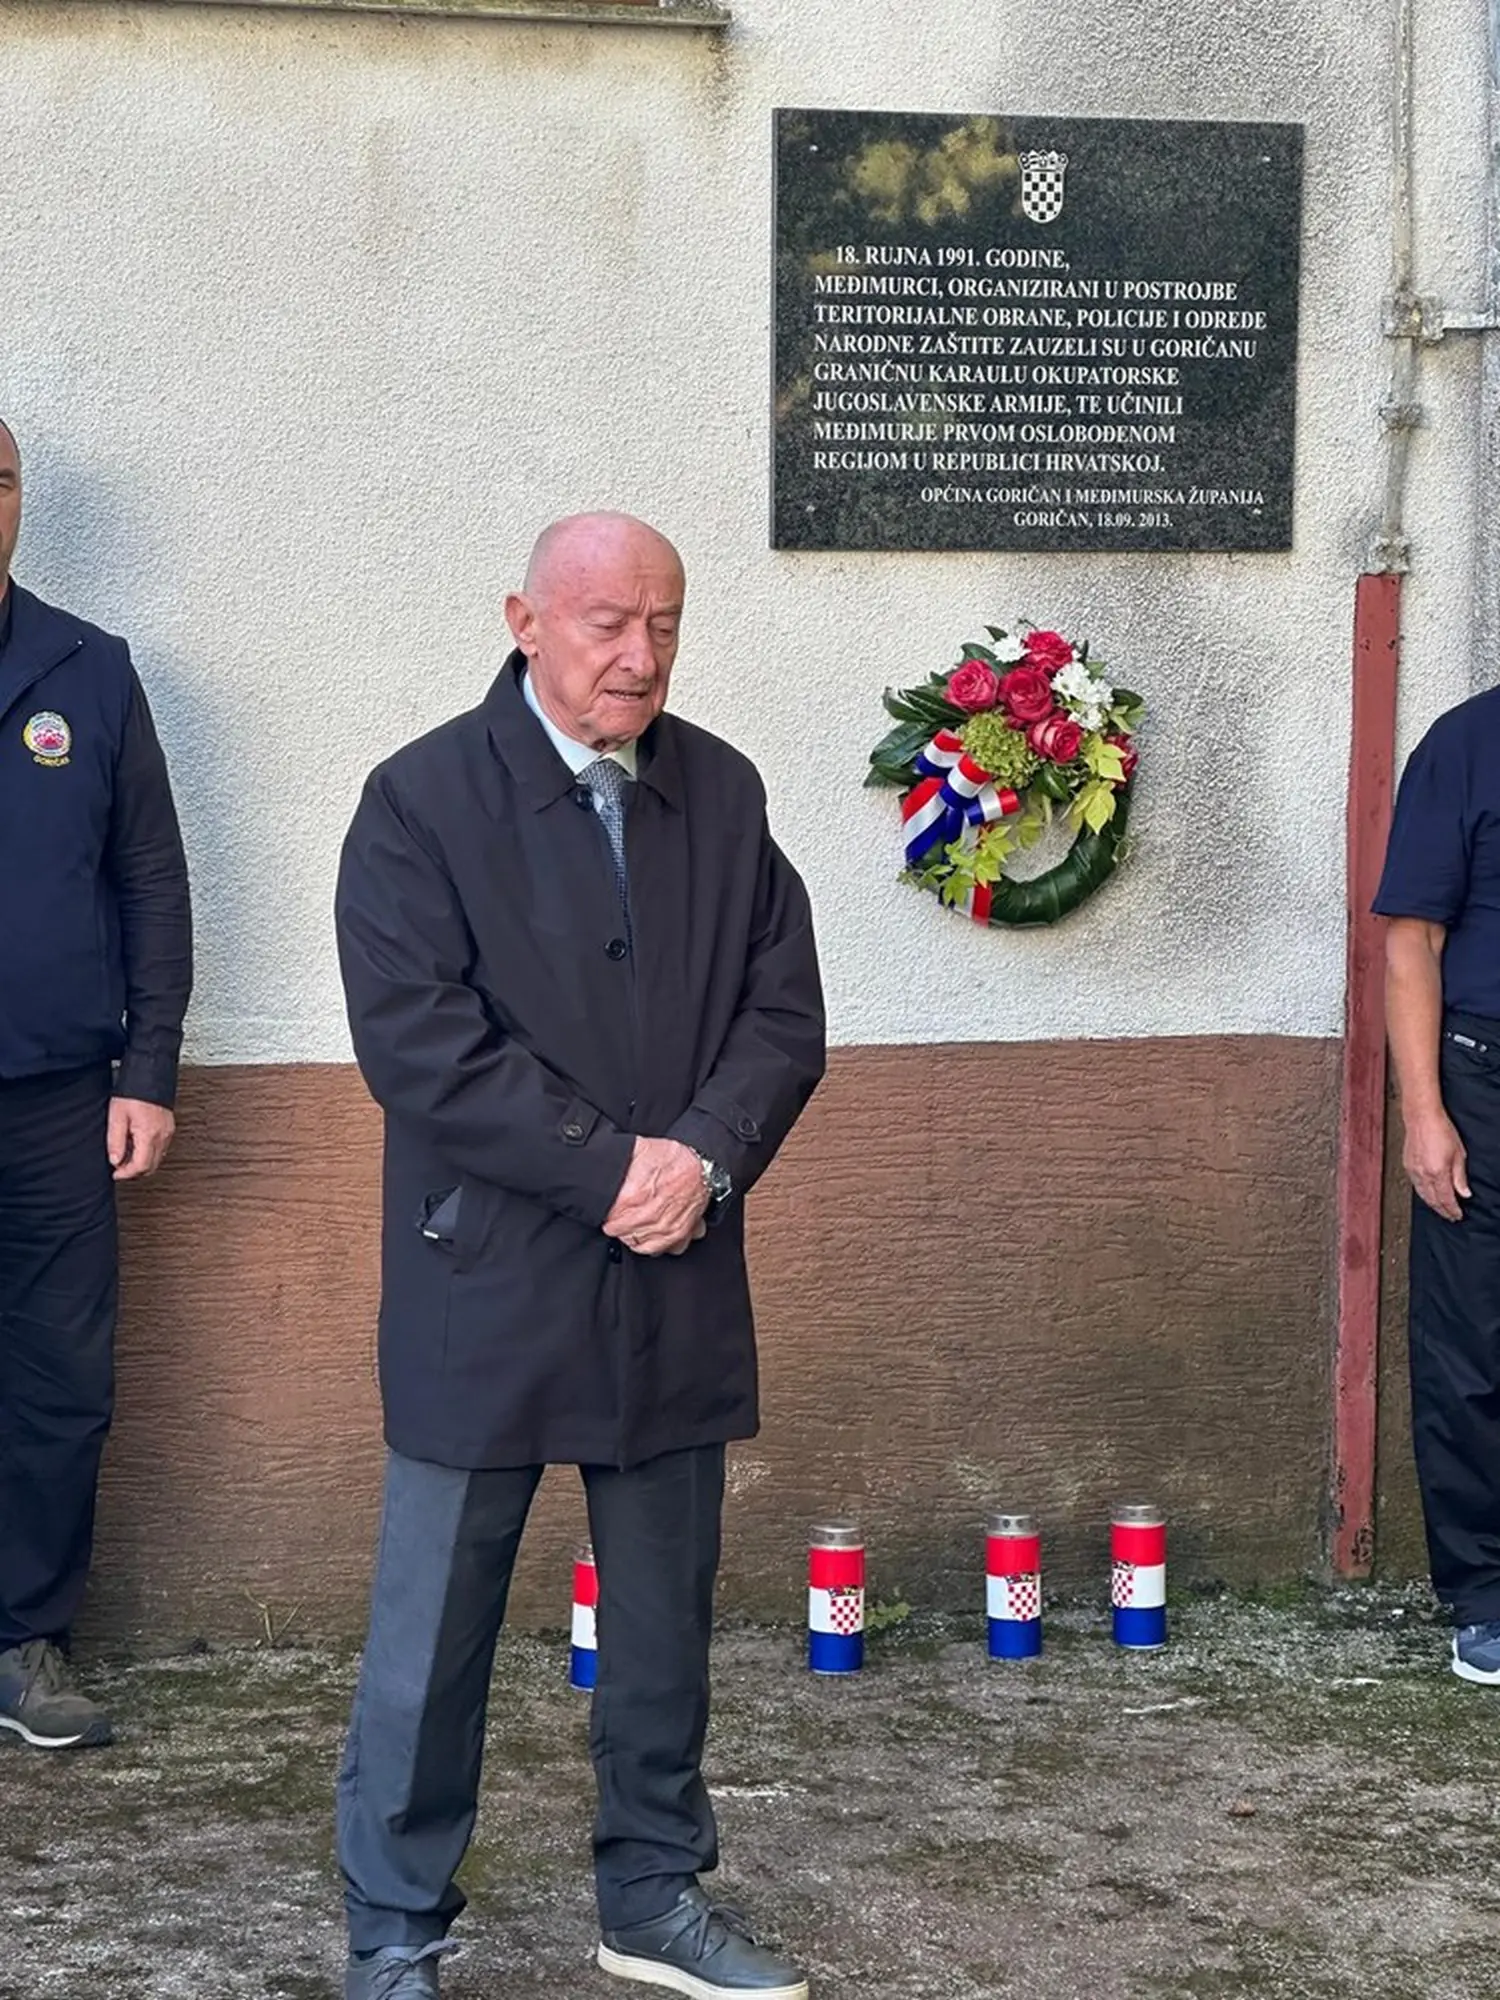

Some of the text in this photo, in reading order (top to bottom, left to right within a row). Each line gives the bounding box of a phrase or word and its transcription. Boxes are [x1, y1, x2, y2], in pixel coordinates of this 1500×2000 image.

[836, 246, 1070, 271] 18. RUJNA 1991. GODINE,
[815, 275, 1237, 301] MEĐIMURCI, ORGANIZIRANI U POSTROJBE
[814, 304, 1266, 330] TERITORIJALNE OBRANE, POLICIJE I ODREDE
[814, 331, 1257, 358] NARODNE ZAŠTITE ZAUZELI SU U GORIČANU
[814, 359, 1179, 385] GRANIČNU KARAULU OKUPATORSKE
[813, 391, 1183, 416] JUGOSLAVENSKE ARMIJE, TE UČINILI
[813, 422, 937, 441] MEĐIMURJE
[944, 424, 1015, 442] PRVOM
[814, 451, 1165, 473] REGIJOM U REPUBLICI HRVATSKOJ.
[921, 484, 982, 503] OPĆINA
[986, 486, 1060, 504] GORIČAN
[1065, 489, 1070, 503] I
[1189, 485, 1264, 505] ŽUPANIJA
[1014, 509, 1093, 528] GORIČAN,
[1140, 512, 1173, 528] 2013.
